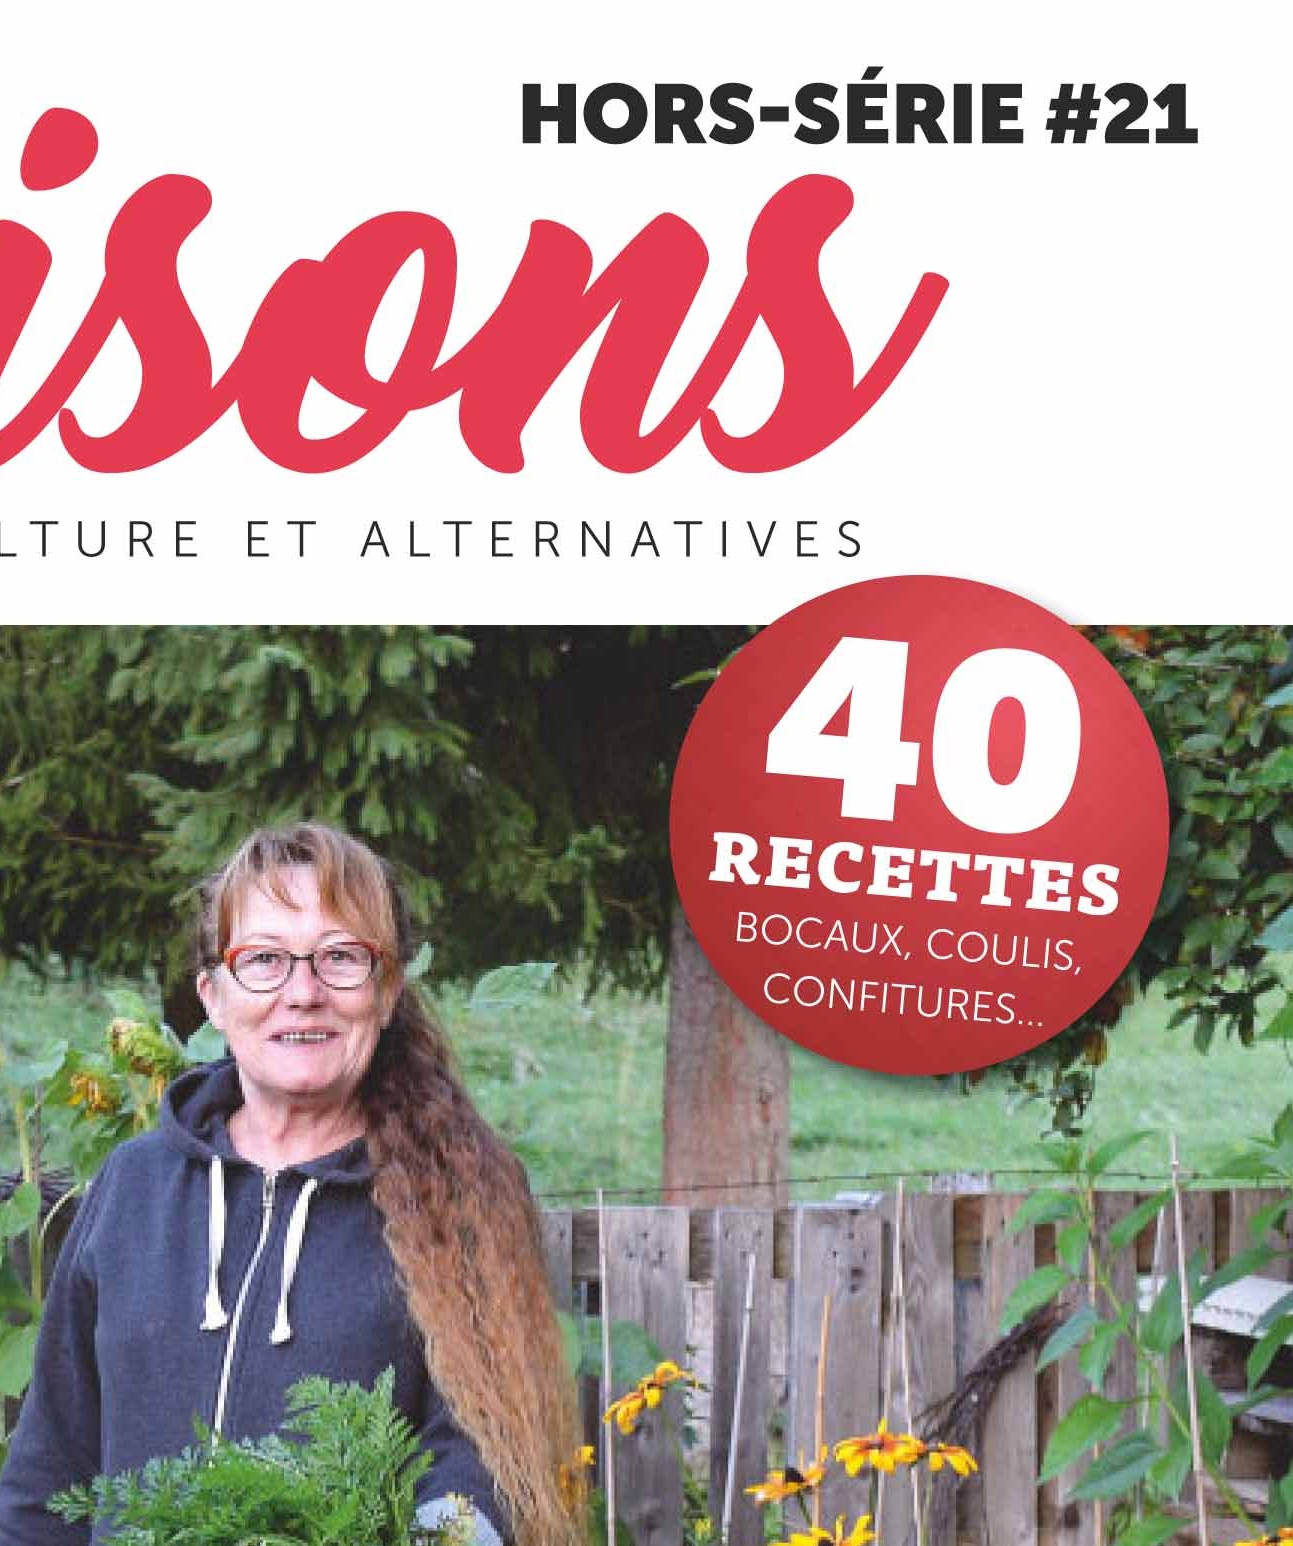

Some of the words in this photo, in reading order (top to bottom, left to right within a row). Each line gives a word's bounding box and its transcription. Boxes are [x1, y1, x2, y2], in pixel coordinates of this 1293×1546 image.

[523, 66, 1023, 144] HORS-SÉRIE
[1046, 83, 1198, 144] #21
[248, 521, 316, 557] ET
[361, 521, 860, 557] ALTERNATIVES
[766, 637, 1080, 833] 40
[709, 831, 1120, 916] RECETTES
[737, 912, 909, 960] BOCAUX,
[928, 929, 1080, 974] COULIS,
[764, 973, 1041, 1025] CONFITURES...
